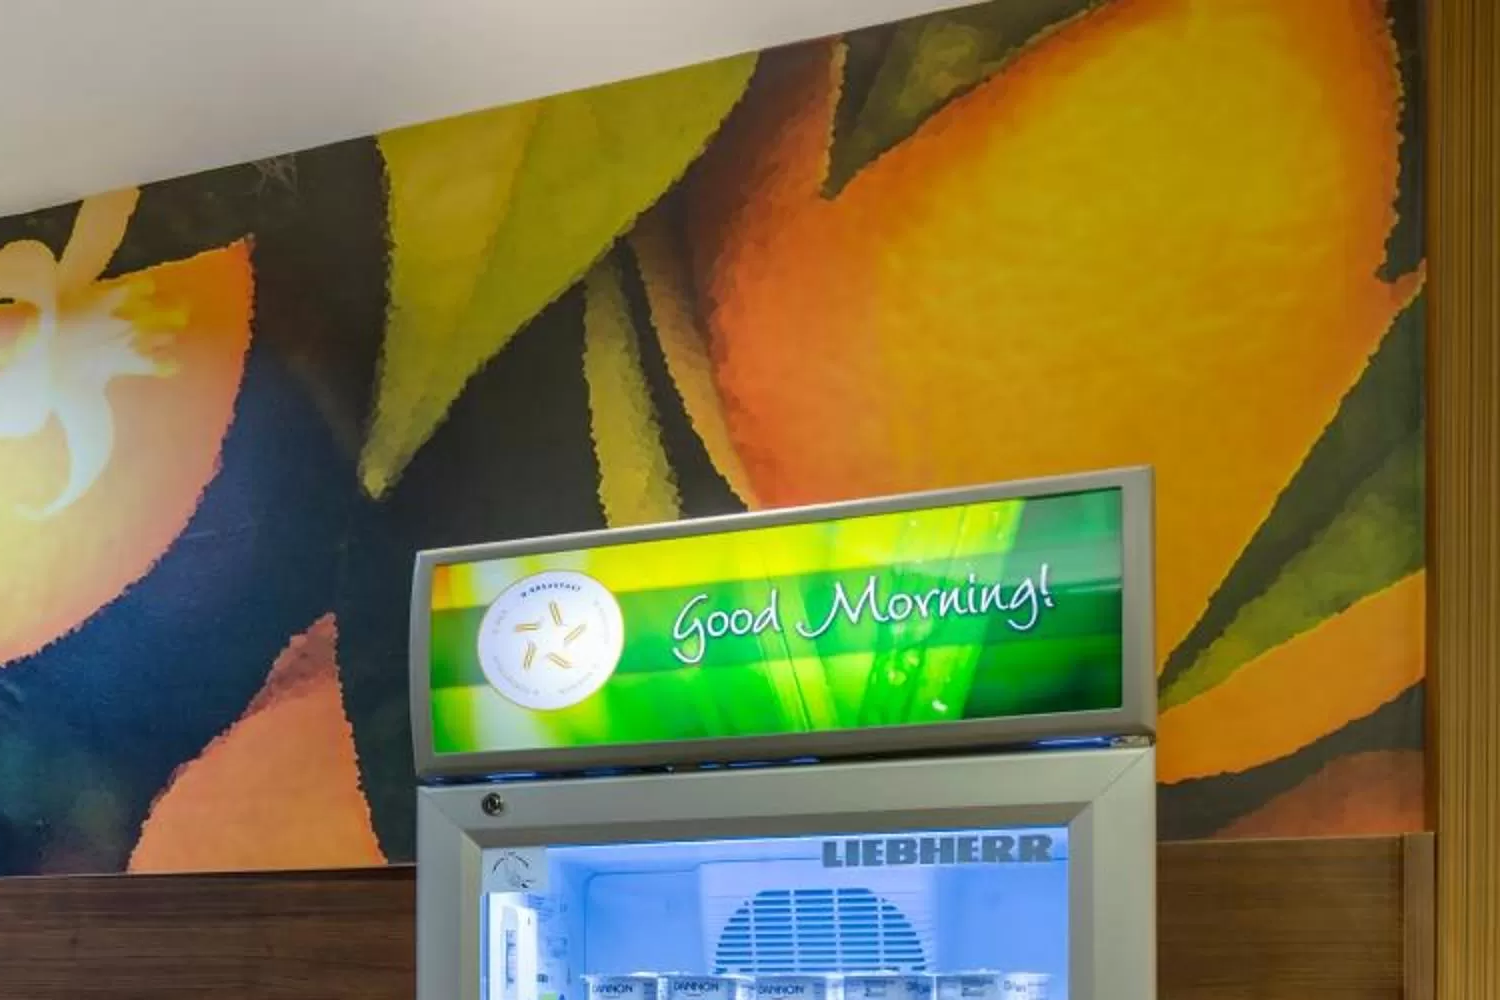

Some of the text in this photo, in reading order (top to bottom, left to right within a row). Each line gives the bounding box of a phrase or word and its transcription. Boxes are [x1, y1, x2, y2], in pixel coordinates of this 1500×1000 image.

[672, 588, 782, 663] Good
[795, 563, 1054, 637] Morning!
[822, 835, 1053, 868] LIEBHERR
[673, 981, 719, 992] DANNON
